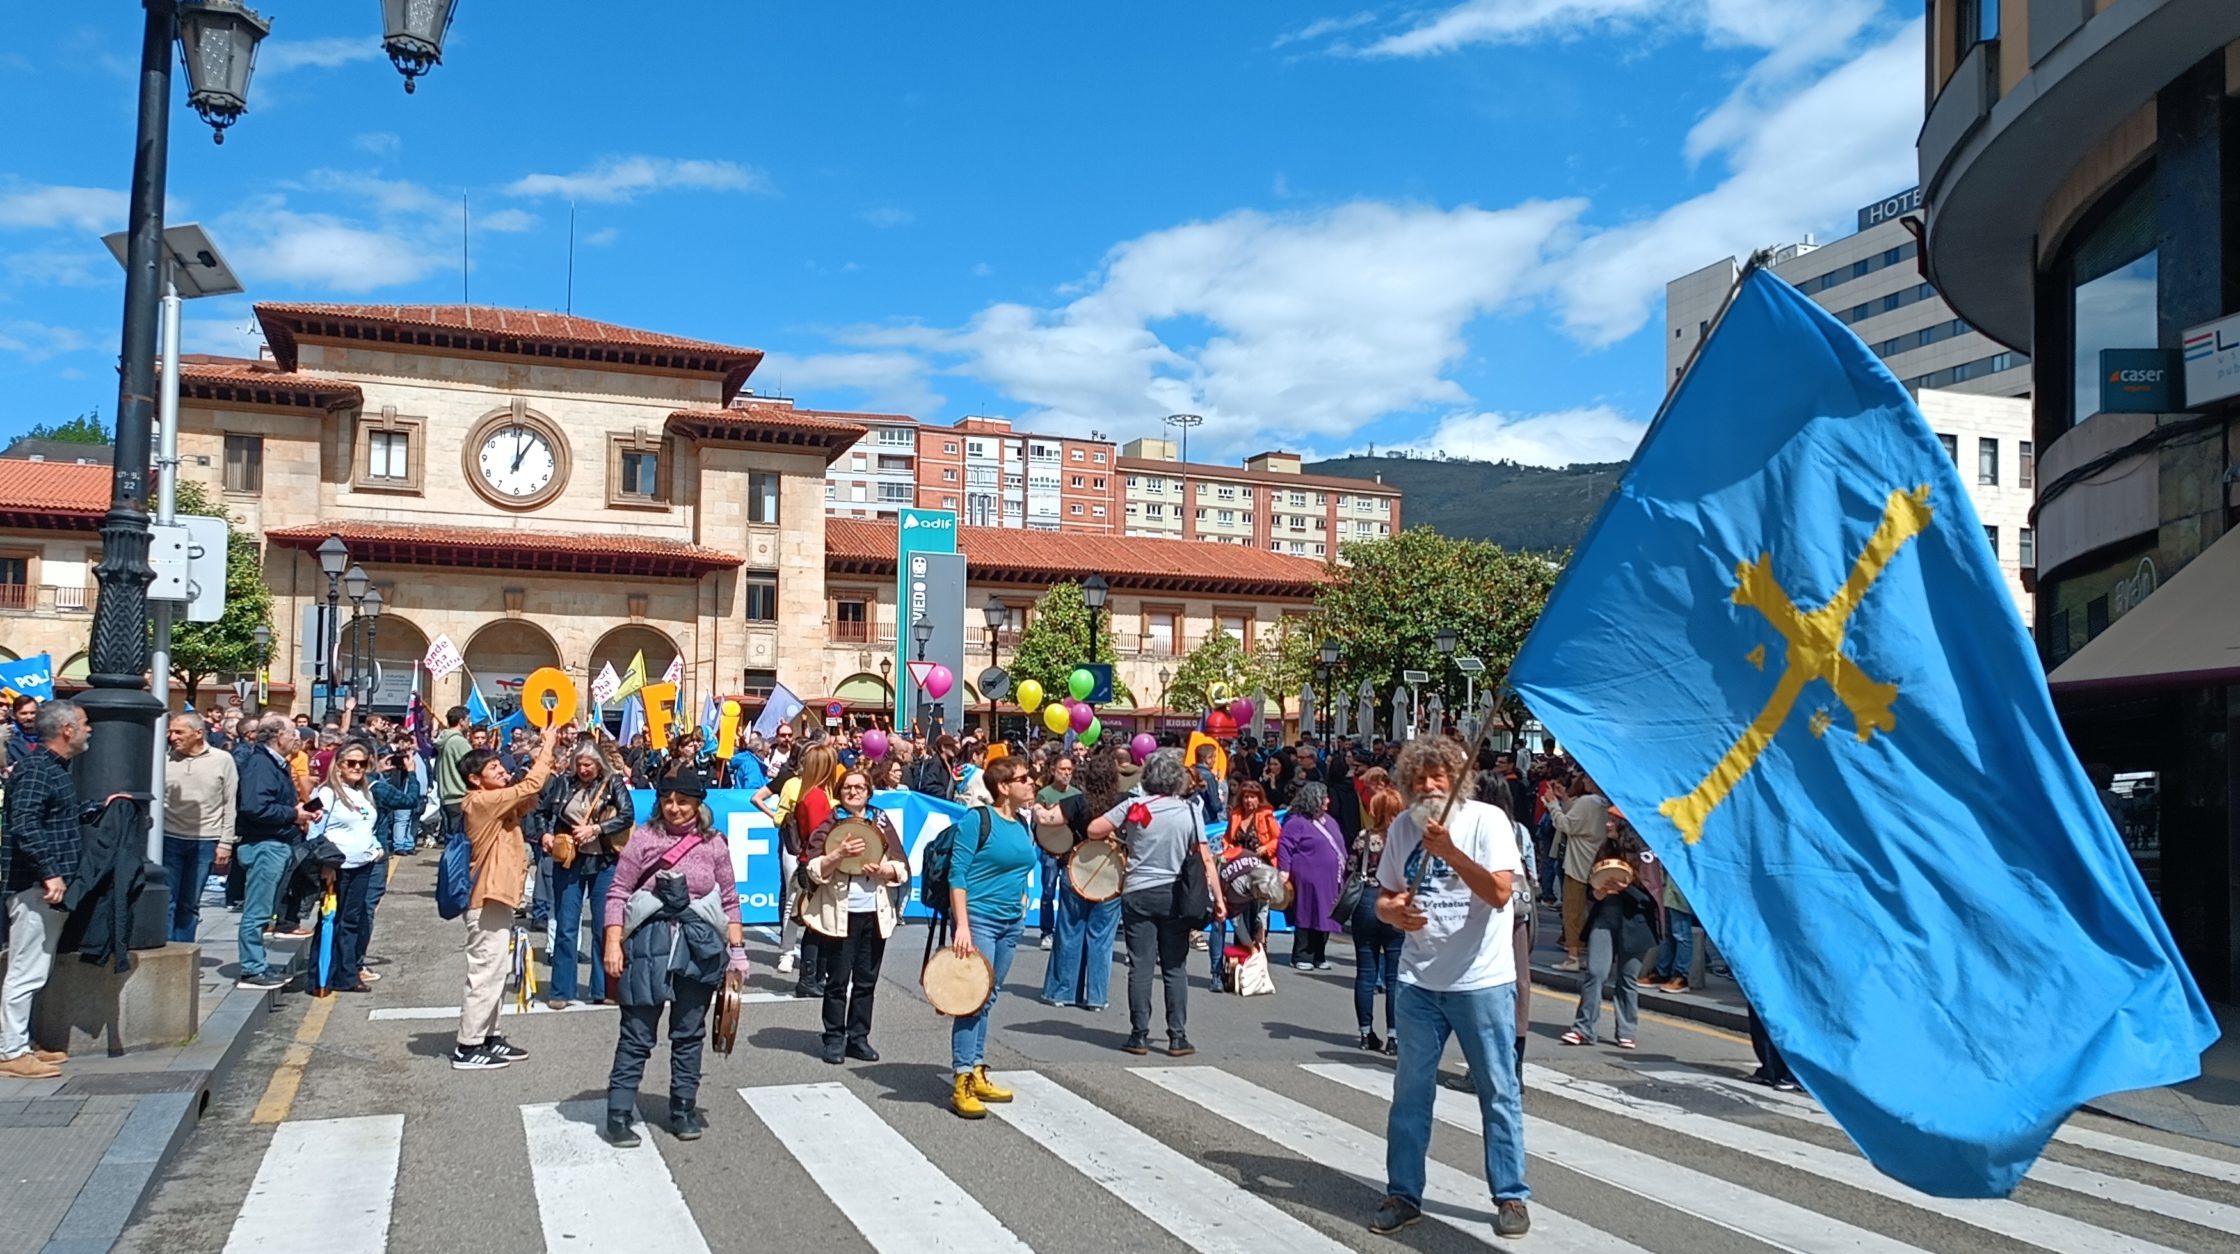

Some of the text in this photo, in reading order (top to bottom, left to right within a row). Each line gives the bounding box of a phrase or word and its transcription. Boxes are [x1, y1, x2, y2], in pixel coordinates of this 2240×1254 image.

[2120, 369, 2164, 382] caser
[513, 427, 523, 437] 12
[487, 440, 496, 449] 10
[481, 454, 488, 463] 9
[485, 469, 492, 478] 8
[123, 481, 136, 490] 22
[497, 480, 503, 488] 7
[530, 483, 537, 492] 5
[513, 487, 520, 496] 6
[920, 518, 953, 529] adif
[640, 682, 677, 750] F
[1165, 719, 1198, 728] KIOSKO
